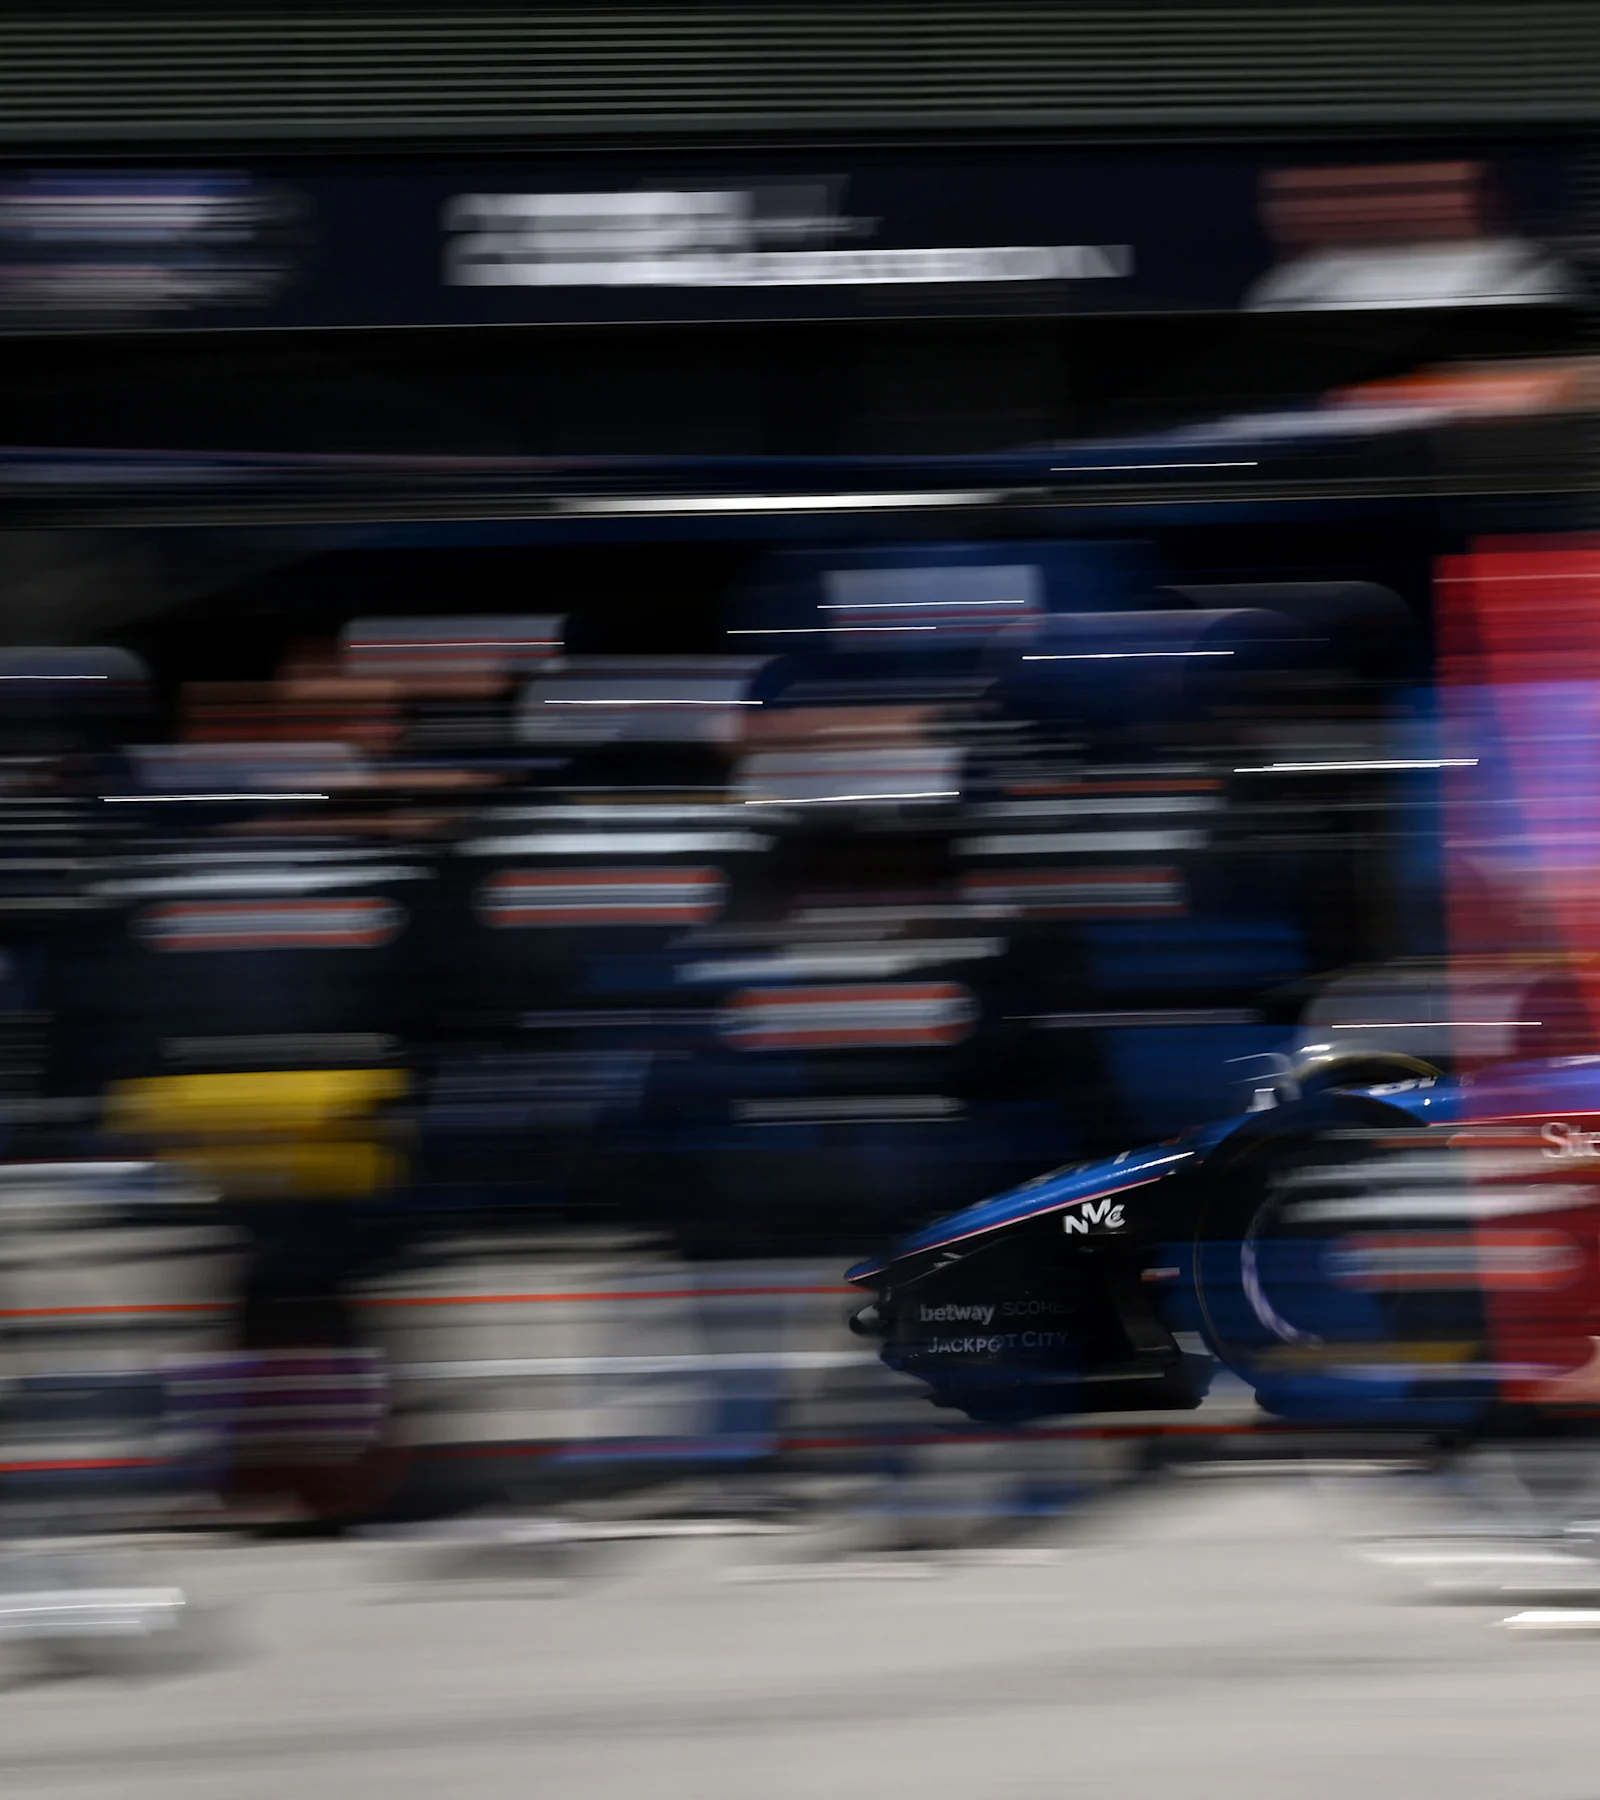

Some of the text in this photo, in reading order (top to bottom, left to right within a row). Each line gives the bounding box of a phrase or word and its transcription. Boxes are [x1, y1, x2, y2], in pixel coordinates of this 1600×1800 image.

[919, 1303, 995, 1326] betway
[928, 1330, 1068, 1354] JACKPOT CITY
